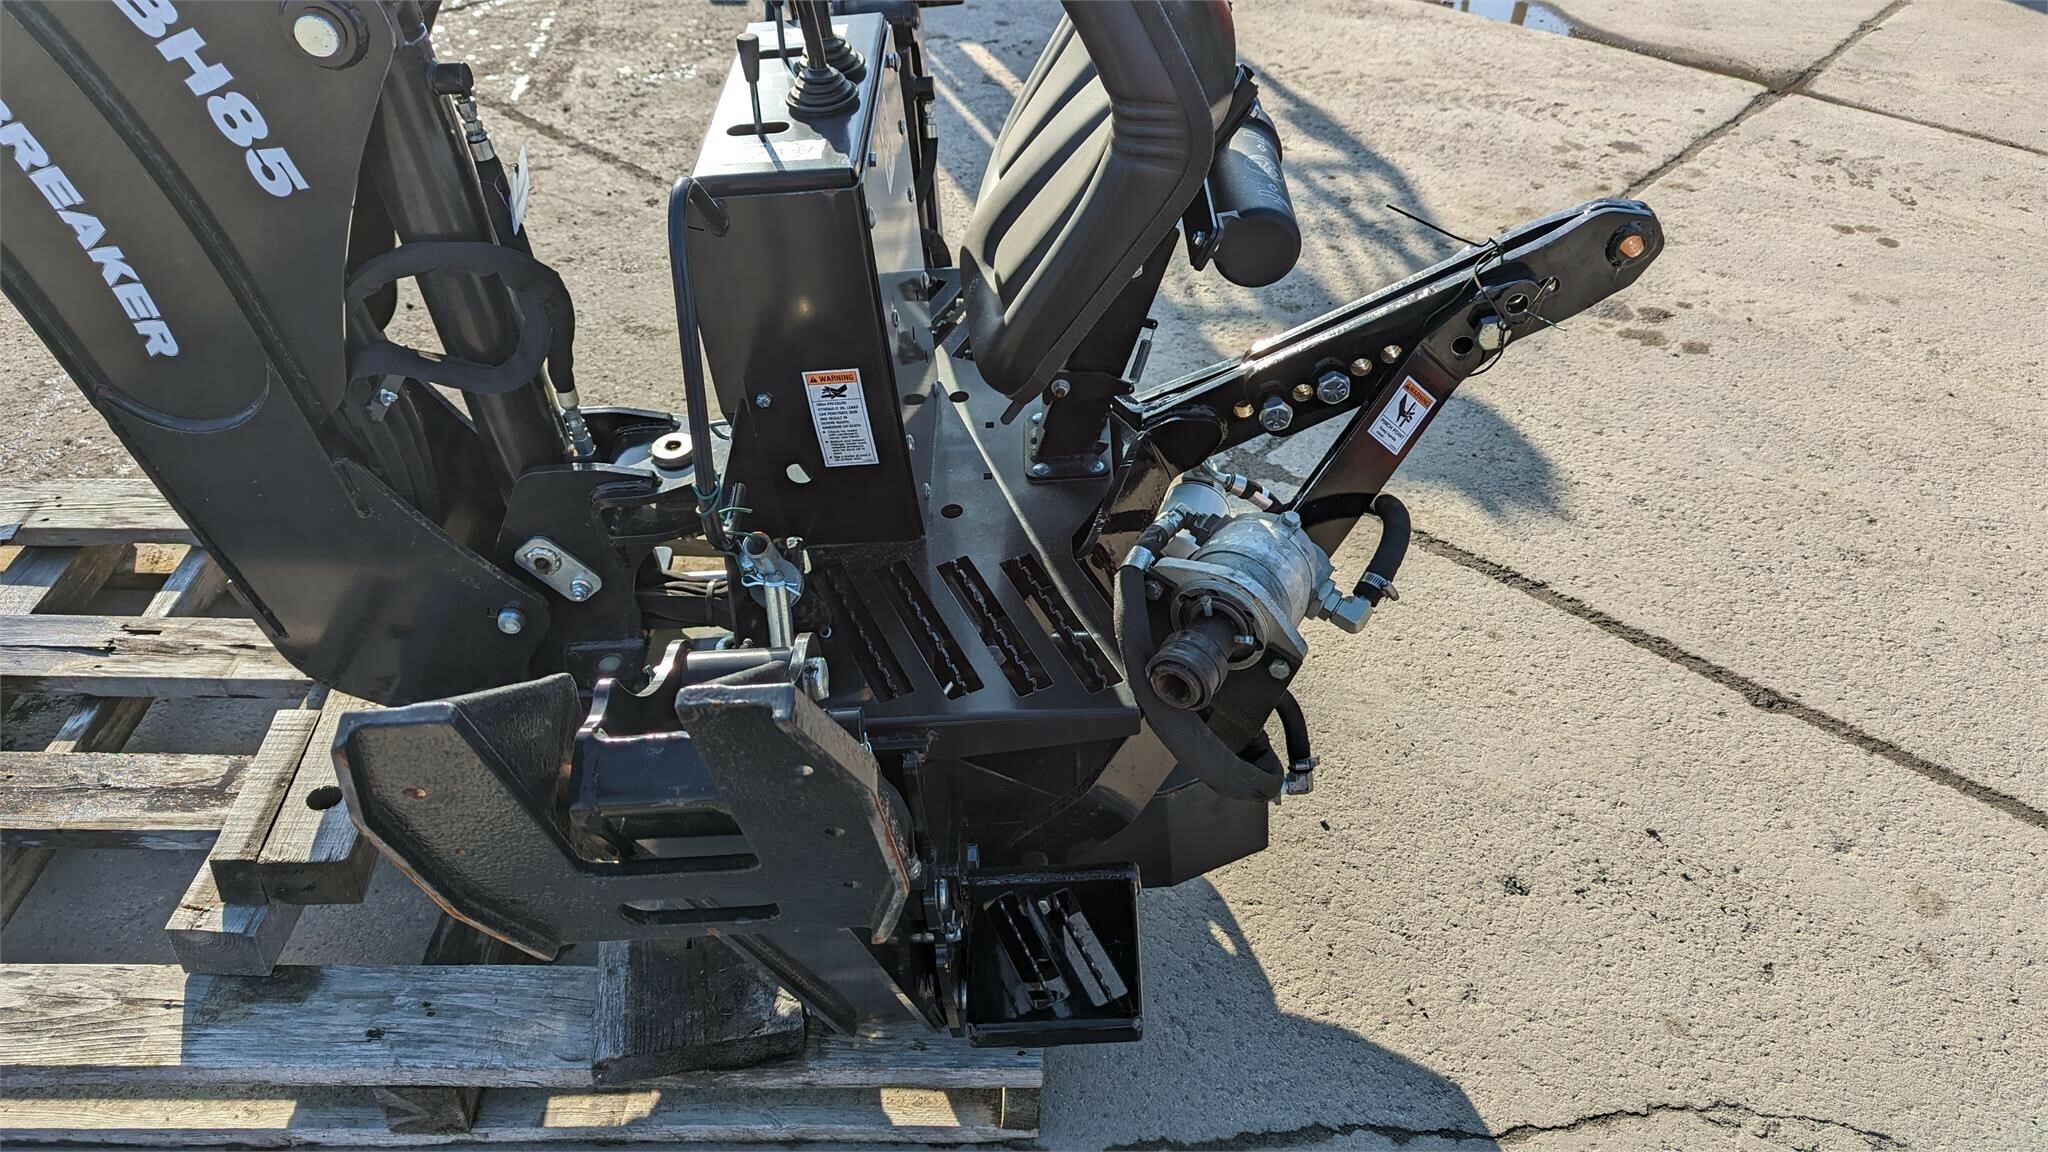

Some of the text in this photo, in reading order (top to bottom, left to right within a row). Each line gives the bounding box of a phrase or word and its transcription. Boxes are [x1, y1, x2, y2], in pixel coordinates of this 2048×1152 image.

[112, 0, 310, 197] BH85
[819, 374, 854, 382] WARNING
[1409, 385, 1431, 407] WARNING
